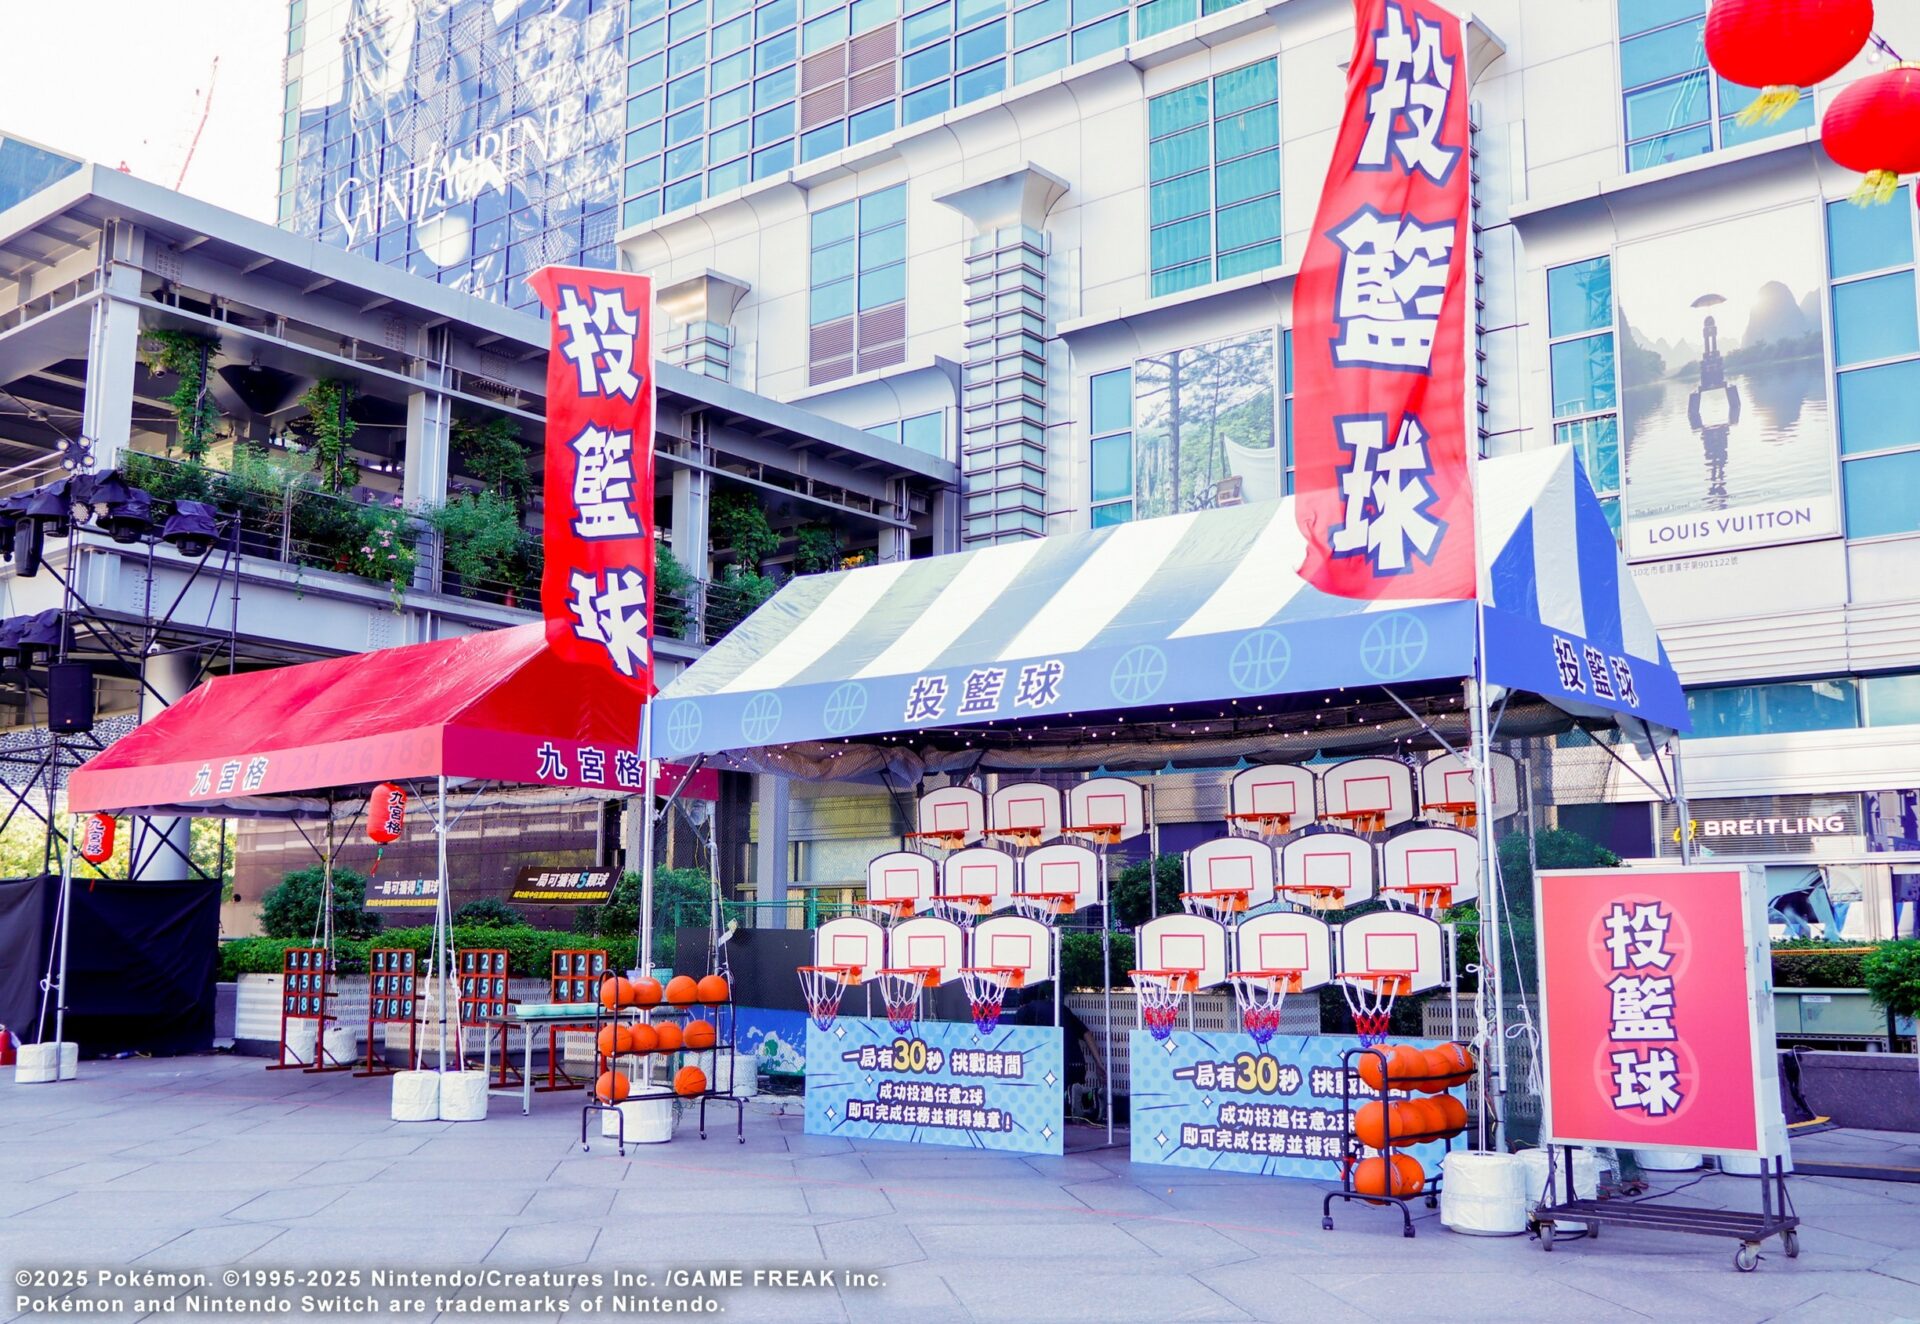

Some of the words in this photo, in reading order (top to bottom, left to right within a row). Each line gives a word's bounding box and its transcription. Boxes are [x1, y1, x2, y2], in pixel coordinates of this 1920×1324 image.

[334, 160, 420, 251] SAINT
[417, 101, 566, 228] LAURENT
[1335, 6, 1456, 569] 投籃球
[558, 287, 648, 676] 投籃球
[1649, 521, 1710, 544] LOUIS
[1716, 507, 1811, 534] VUITTON
[1553, 634, 1639, 708] 投籃球
[904, 660, 1064, 722] 投籃球
[189, 756, 269, 797] 九宮格
[536, 741, 643, 787] 九宮格
[384, 791, 406, 836] 九宮格
[1704, 815, 1844, 836] BREITLING
[87, 818, 105, 855] 九宮格
[291, 953, 297, 967] 1
[303, 953, 309, 967] 2
[316, 953, 322, 967] 3
[378, 953, 383, 968] 1
[391, 953, 398, 968] 2
[405, 953, 412, 968] 3
[467, 954, 474, 969] 1
[482, 954, 488, 969] 2
[497, 954, 504, 969] 3
[561, 956, 568, 971] 1
[578, 956, 585, 971] 2
[595, 956, 602, 971] 3
[290, 975, 296, 988] 4
[302, 975, 308, 988] 5
[314, 975, 321, 988] 6
[377, 976, 384, 991] 4
[391, 976, 398, 991] 5
[405, 976, 412, 991] 6
[466, 977, 473, 994] 4
[481, 977, 488, 994] 5
[496, 977, 503, 994] 6
[560, 981, 568, 997] 4
[577, 981, 584, 997] 5
[593, 981, 599, 997] 6
[289, 997, 295, 1011] 7
[301, 997, 307, 1011] 8
[313, 997, 320, 1011] 9
[378, 1000, 384, 1014] 7
[390, 1000, 397, 1014] 8
[404, 1000, 412, 1014] 9
[466, 1003, 472, 1017] 7
[480, 1003, 487, 1017] 8
[496, 1003, 503, 1017] 9
[1604, 903, 1682, 1115] 投籃球
[844, 1040, 943, 1072] 一局有30秒
[951, 1051, 1021, 1076] 挑戰時間
[1176, 1055, 1300, 1093] 一局有30秒
[880, 1083, 983, 1105] 成功投進任意2球
